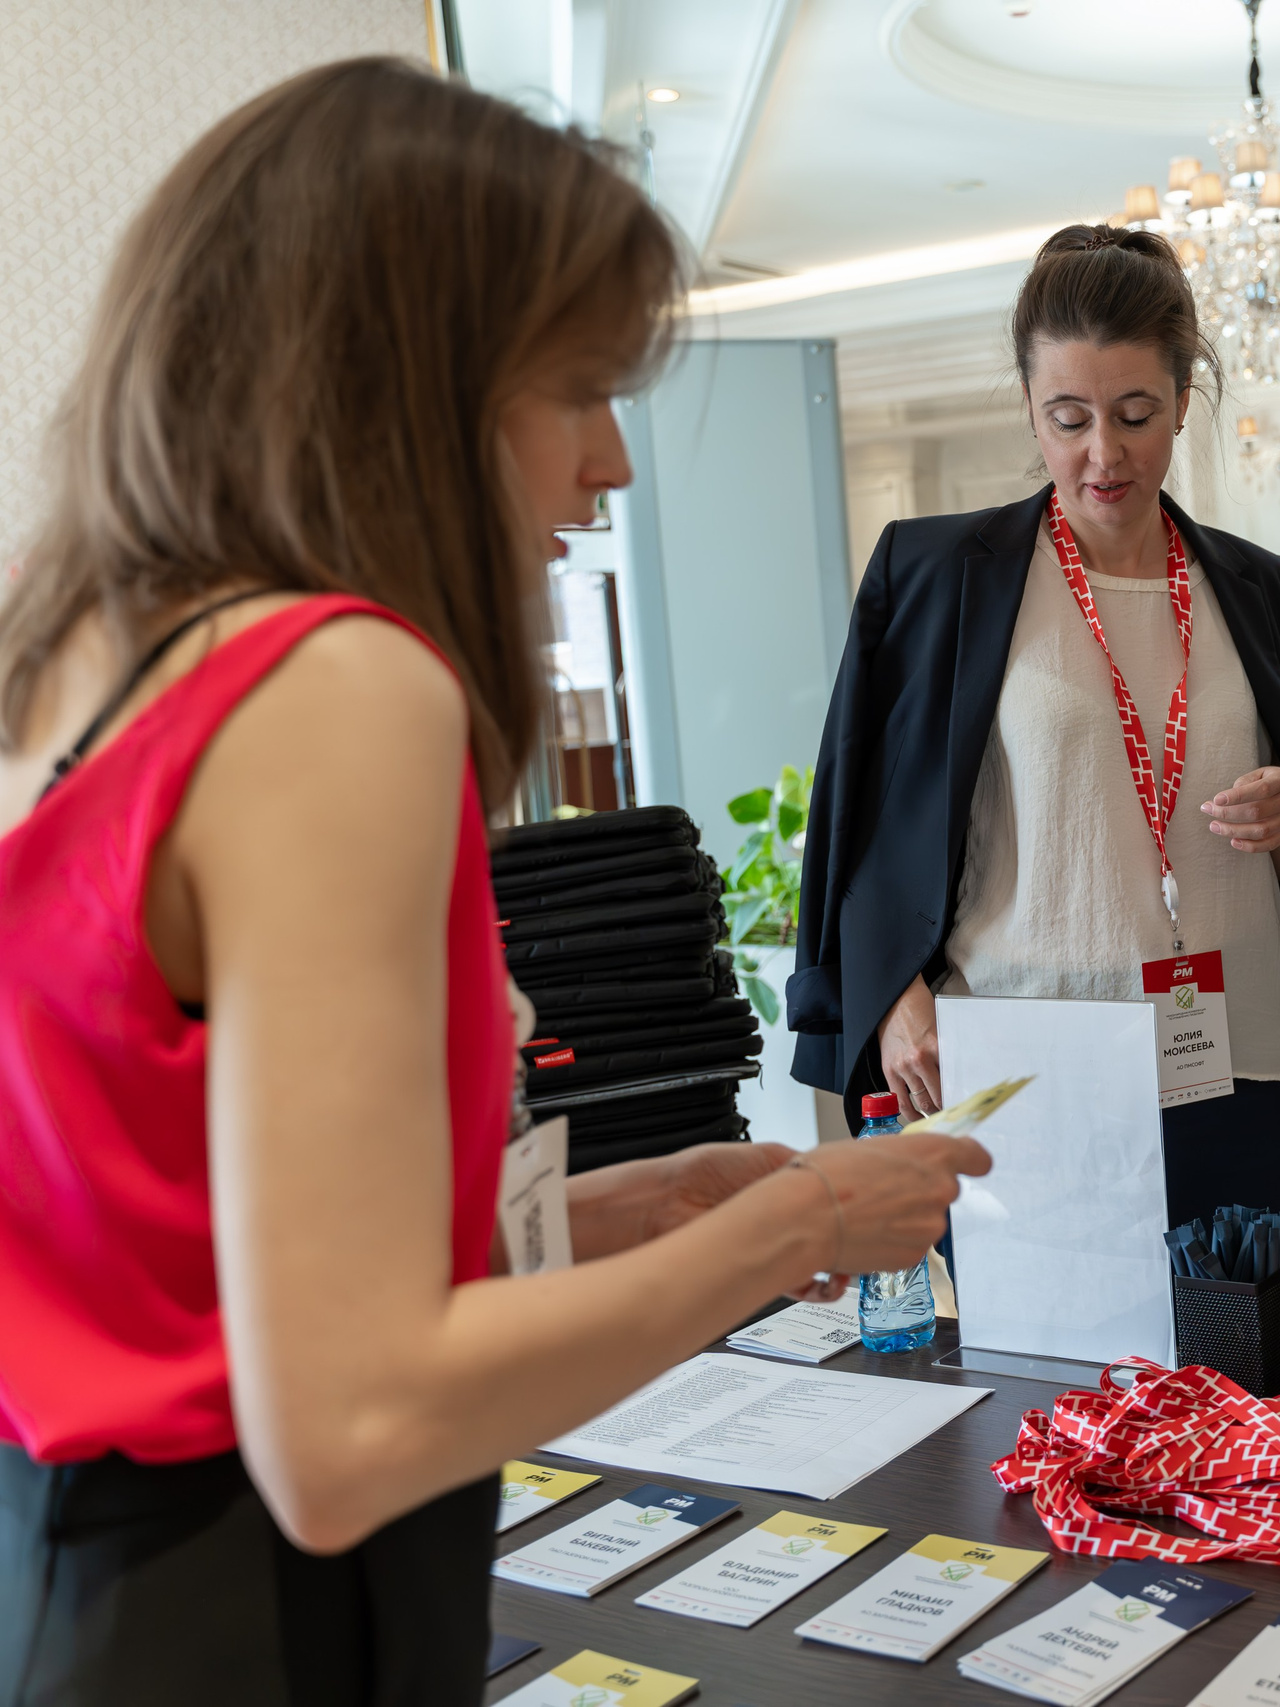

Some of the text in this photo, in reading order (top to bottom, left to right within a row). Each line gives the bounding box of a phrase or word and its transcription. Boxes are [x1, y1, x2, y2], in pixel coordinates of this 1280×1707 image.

[1173, 1029, 1203, 1043] ЮЛИЯ
[1163, 1040, 1215, 1058] МОИСЕЕВА
[569, 1537, 626, 1555] БАКЕВИЧ
[582, 1530, 641, 1547] ВИТАЛИЙ
[717, 1569, 780, 1587] ВАГАРИН
[722, 1560, 800, 1580] ВЛАДИМИР
[875, 1597, 944, 1616] ГЛАДКОВ
[890, 1588, 954, 1607] МИХАИЛ
[1038, 1631, 1112, 1661] ДЕХТЕВИЧ
[1061, 1625, 1120, 1650] АНДРЕЙ
